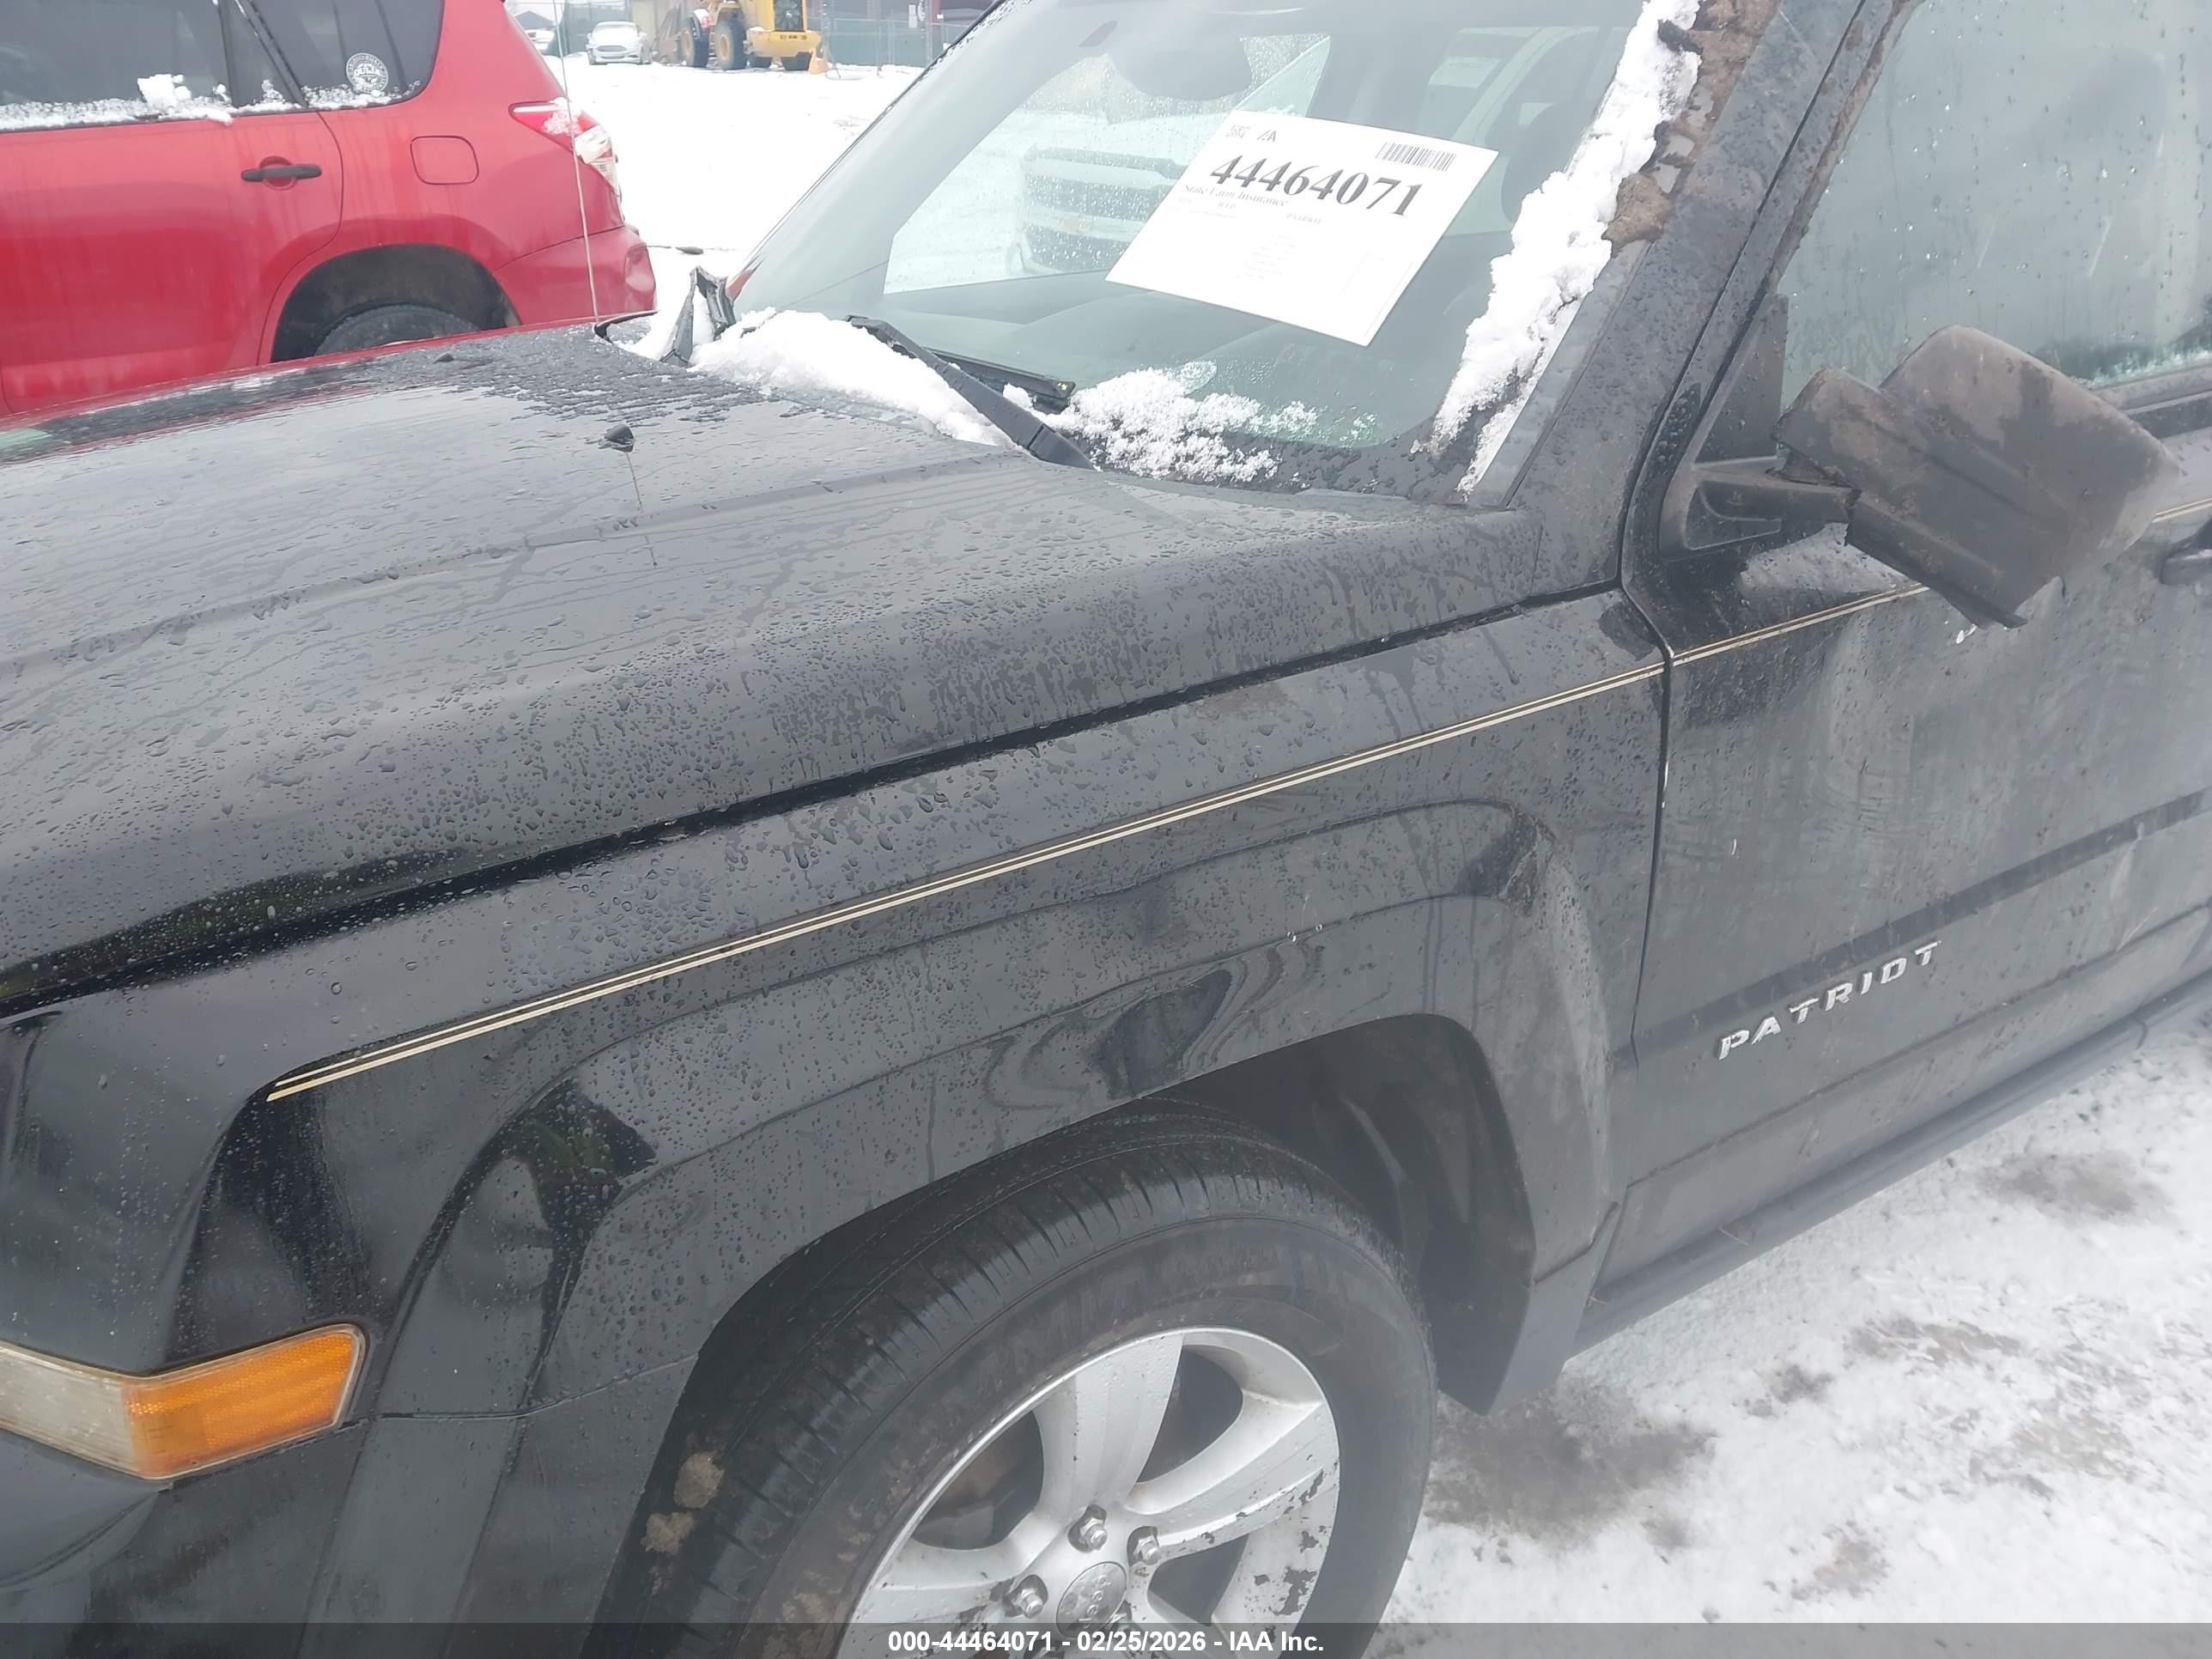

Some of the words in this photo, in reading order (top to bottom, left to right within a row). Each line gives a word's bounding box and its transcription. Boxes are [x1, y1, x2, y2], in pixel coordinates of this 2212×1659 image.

[1210, 155, 1423, 216] 44464071
[1237, 190, 1289, 207] Insurance
[1718, 940, 1941, 1061] PATRIOT
